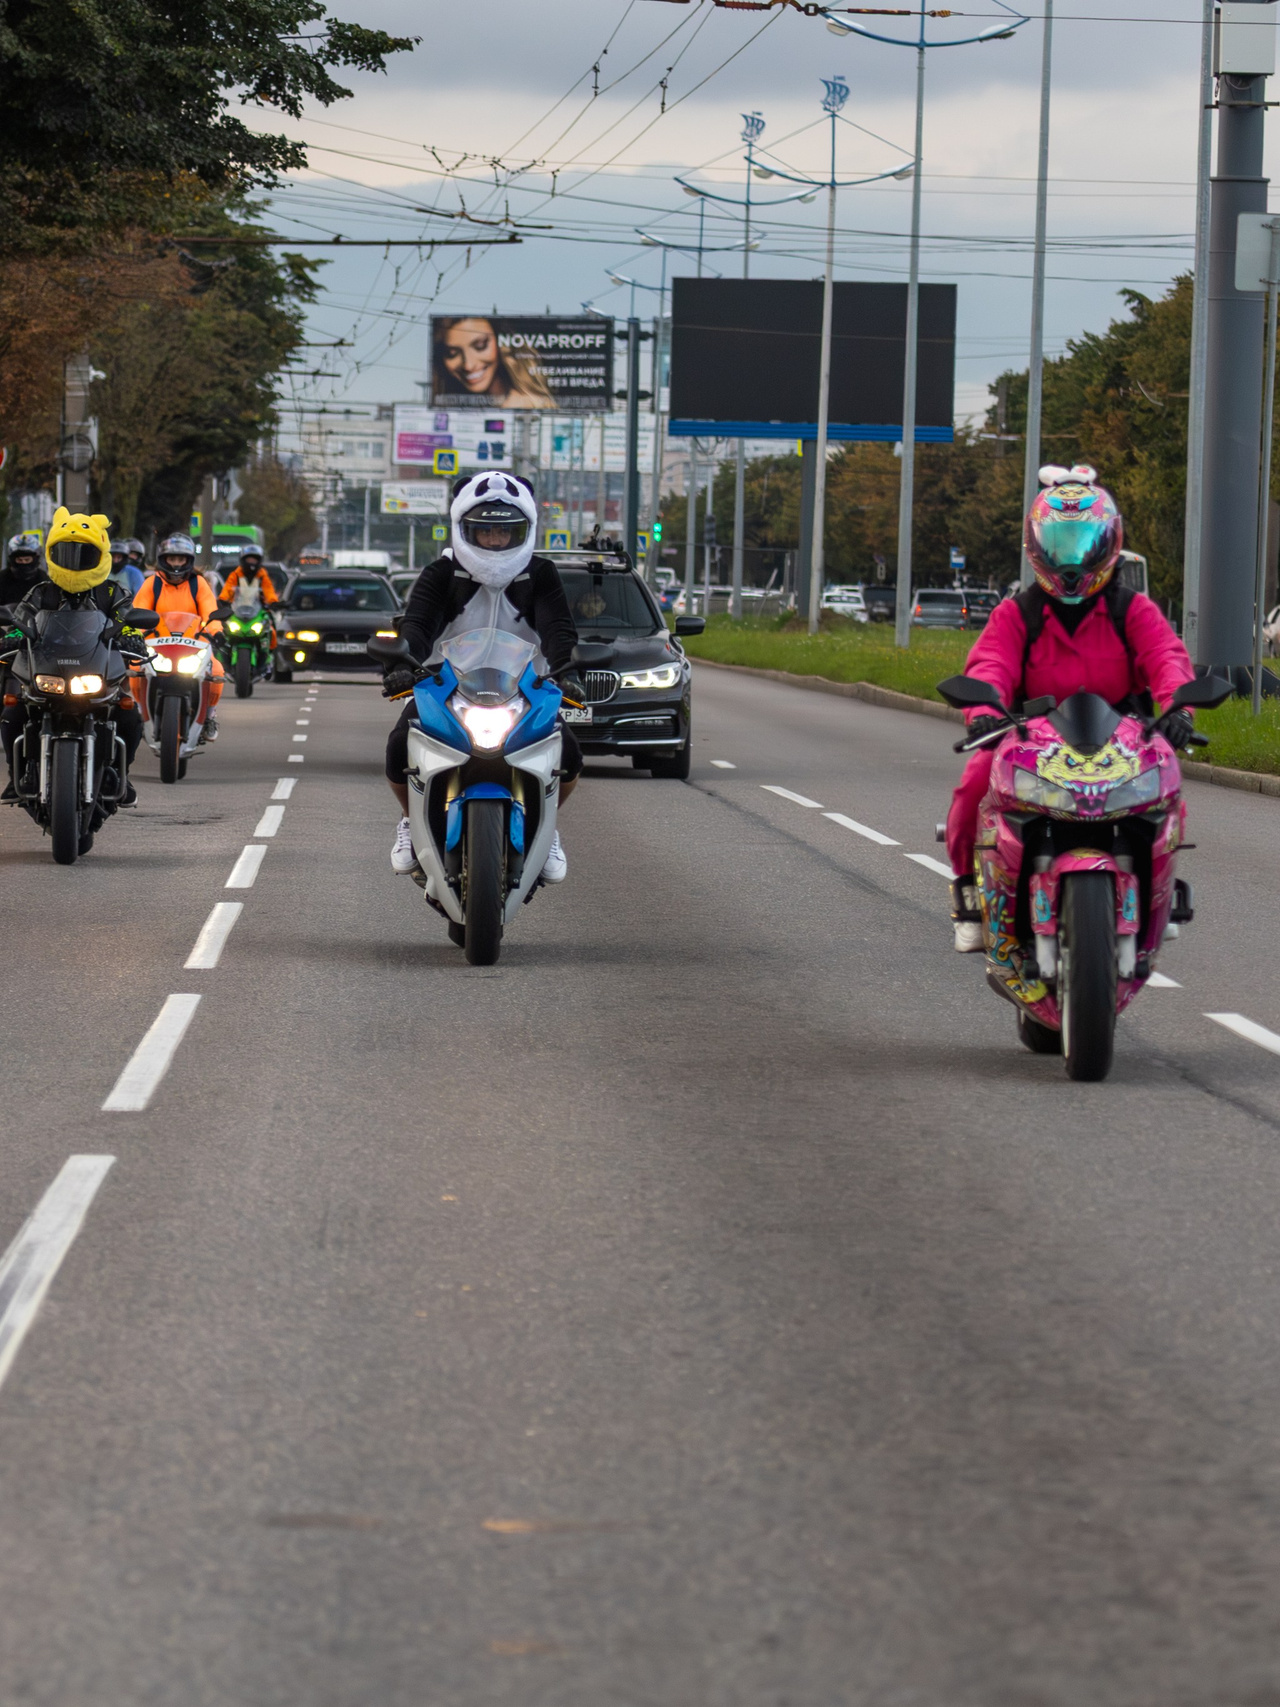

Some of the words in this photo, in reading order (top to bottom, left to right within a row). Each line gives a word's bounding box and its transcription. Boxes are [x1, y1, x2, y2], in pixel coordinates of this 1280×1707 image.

[497, 333, 606, 349] NOVAPROFF
[156, 637, 198, 647] REPSOL
[575, 708, 589, 718] 39
